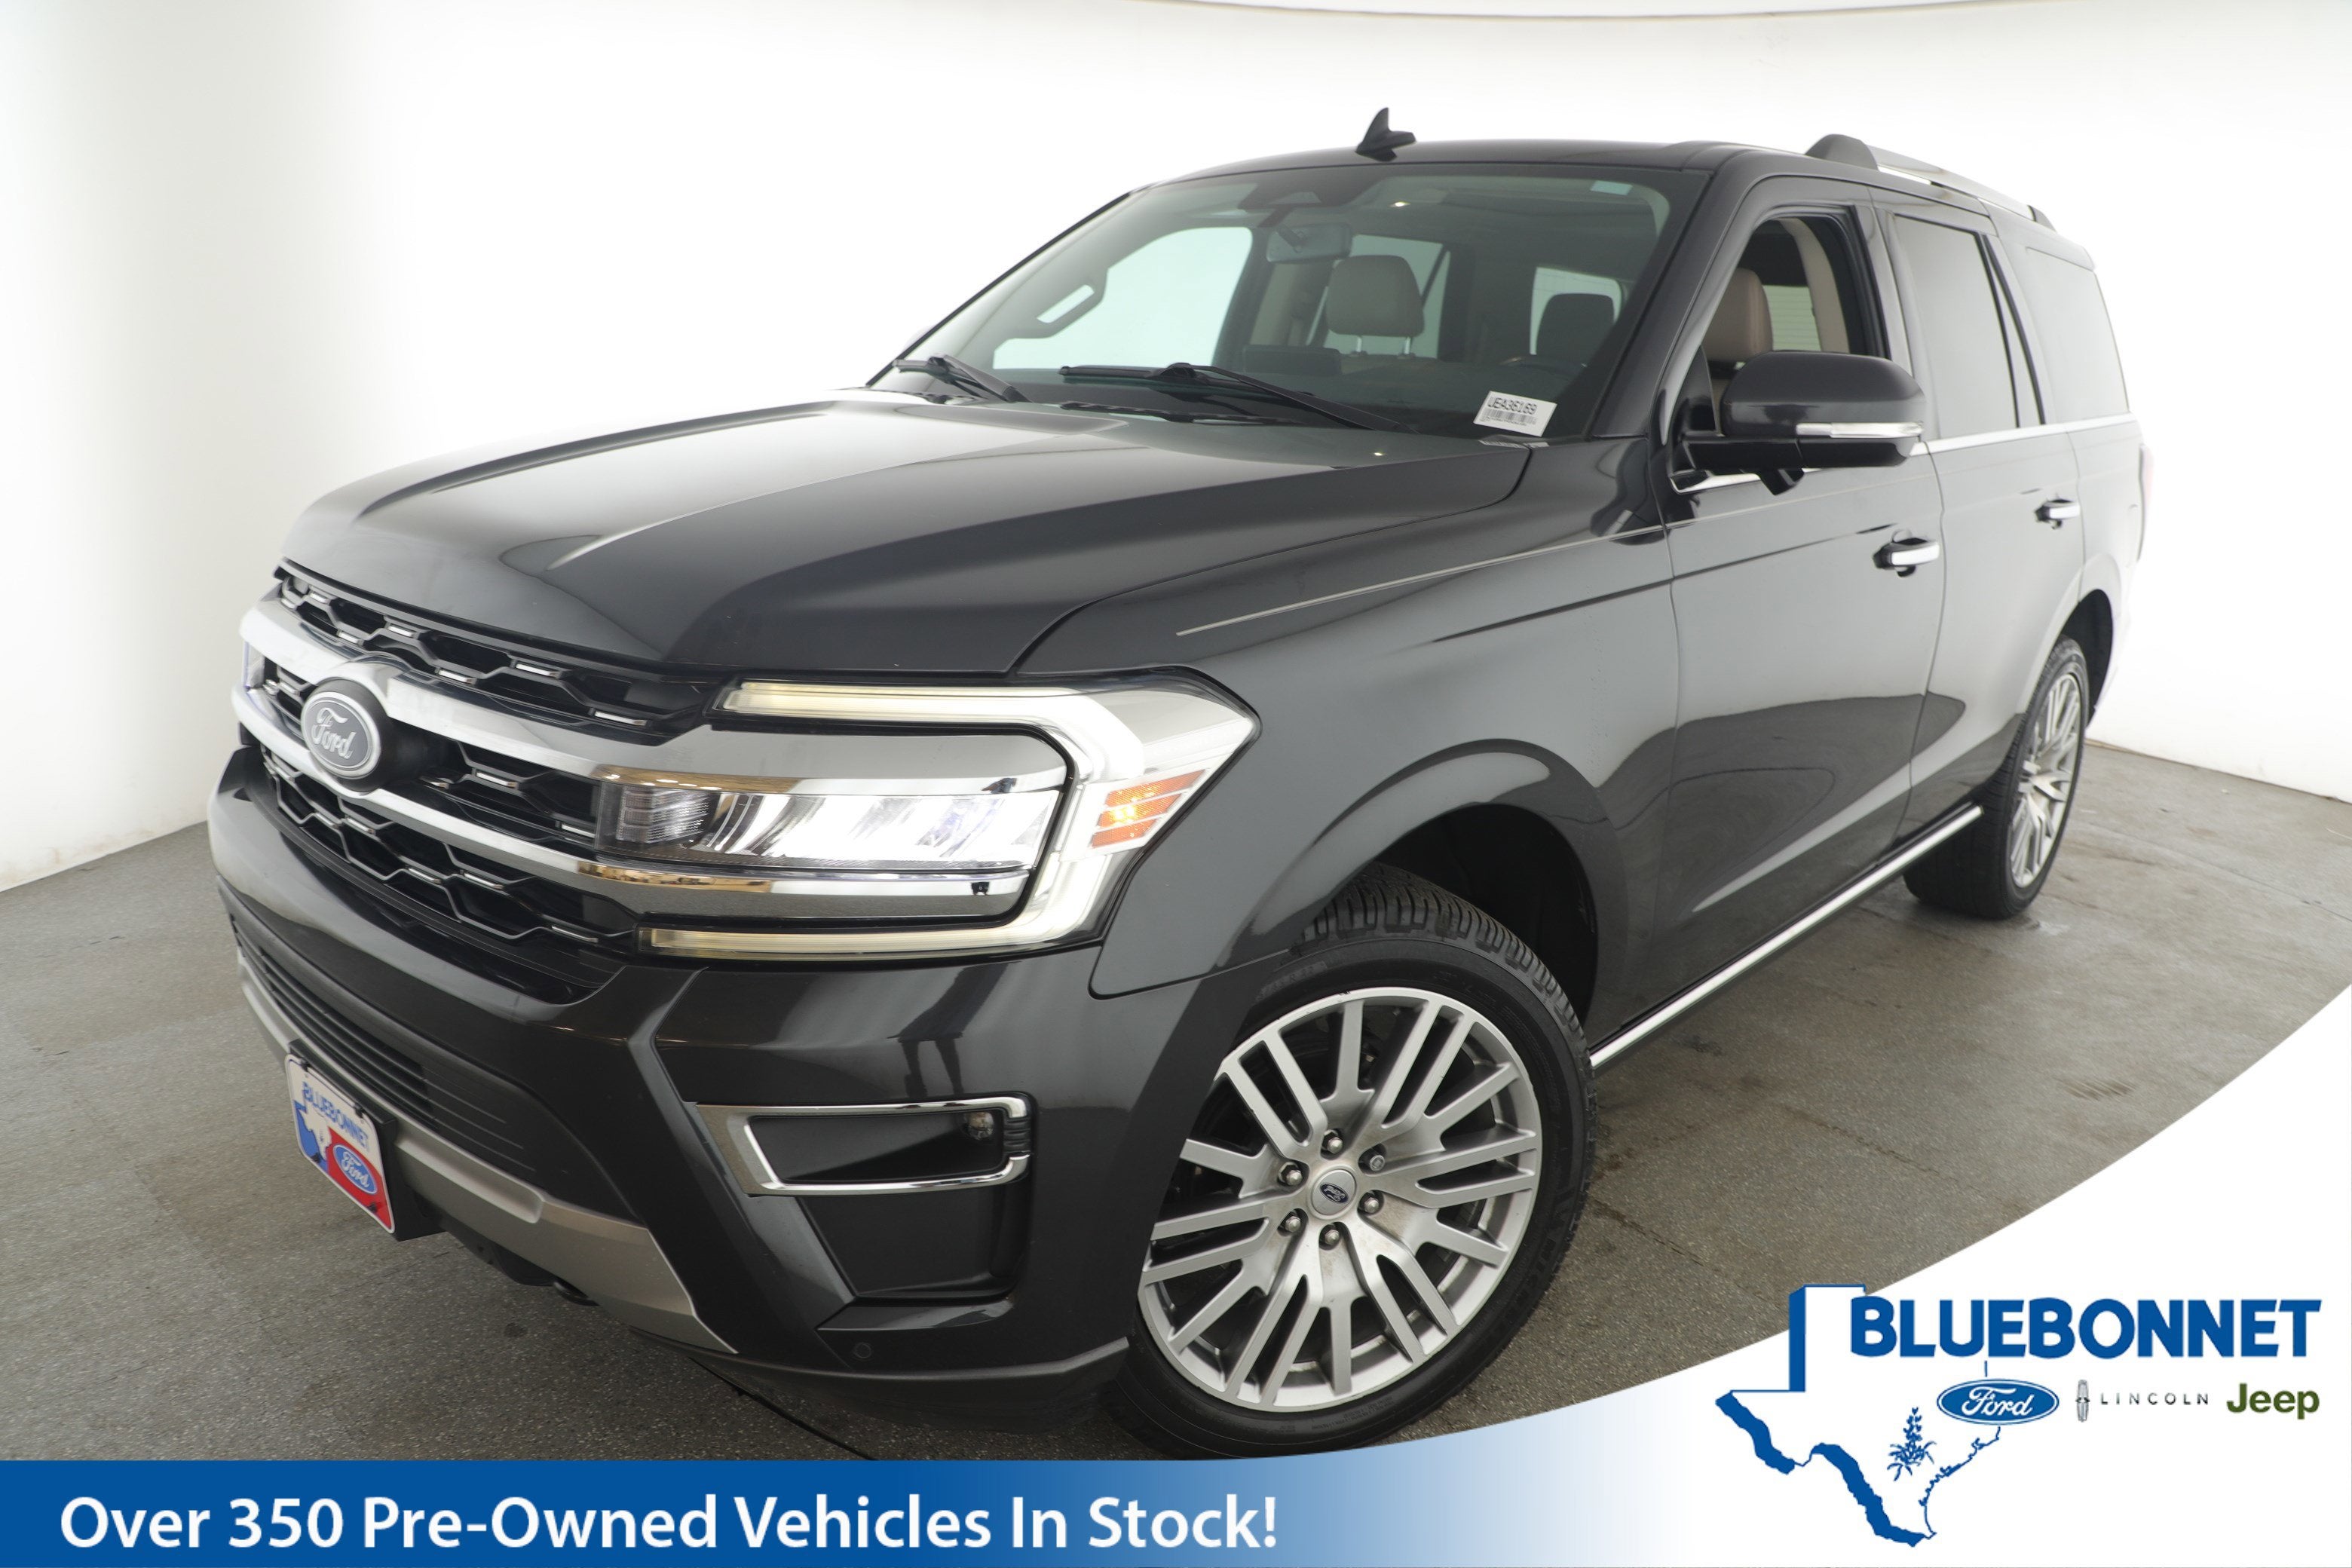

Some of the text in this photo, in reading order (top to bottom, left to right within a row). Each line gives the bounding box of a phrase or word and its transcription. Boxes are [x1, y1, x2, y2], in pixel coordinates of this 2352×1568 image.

[311, 707, 357, 760] Ford
[302, 1081, 371, 1152] BLUEBONNET
[340, 1150, 371, 1189] Ford
